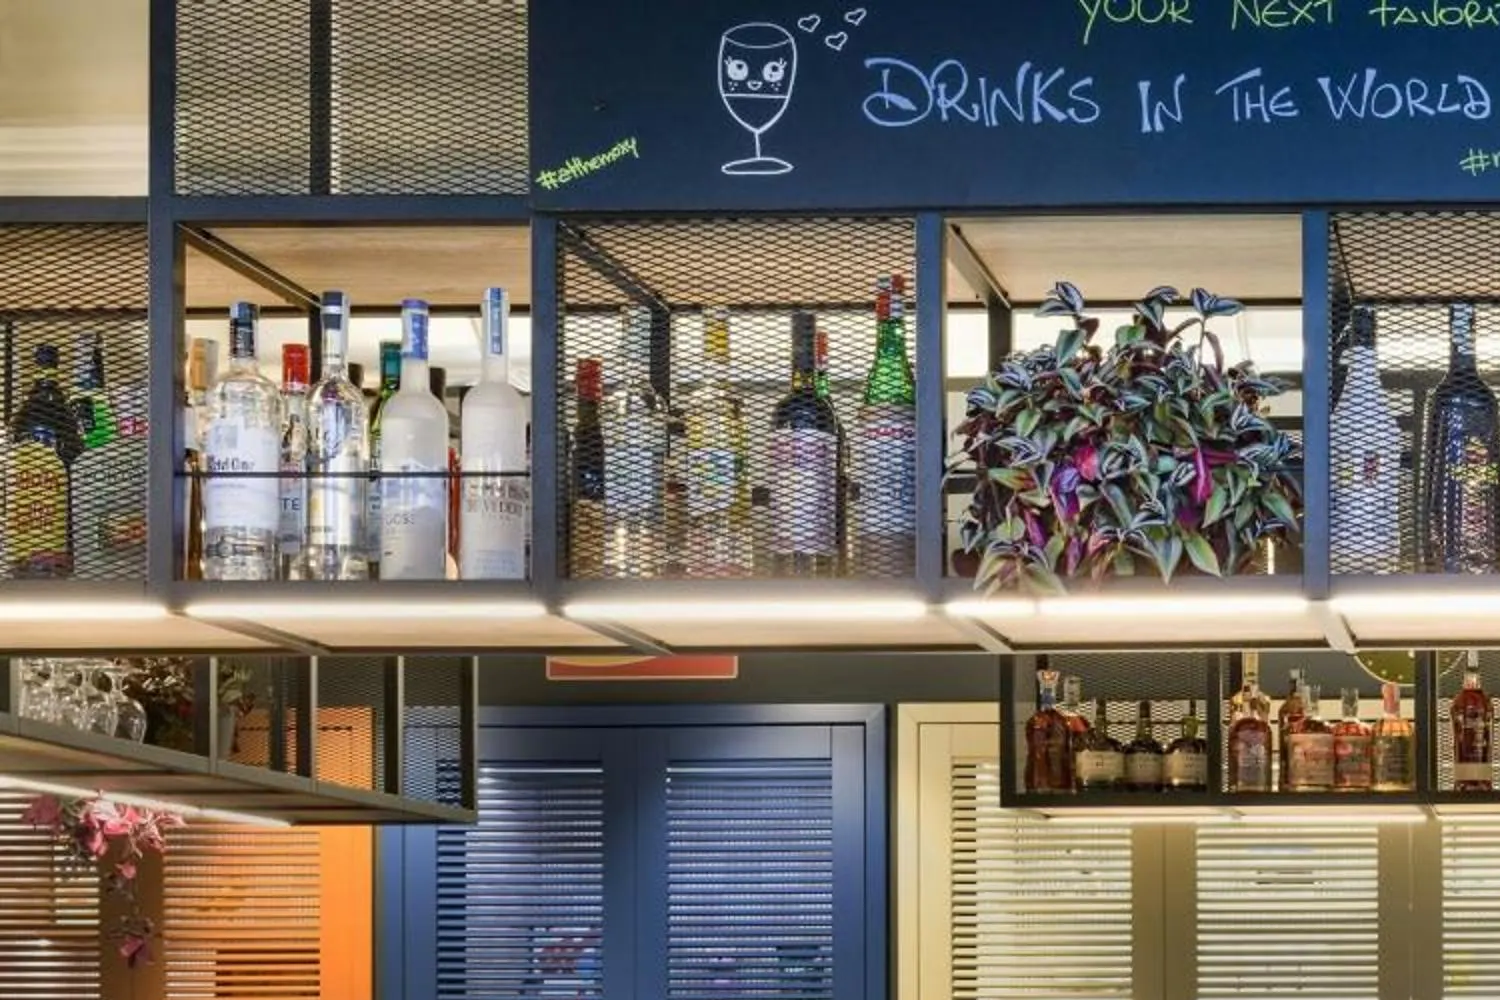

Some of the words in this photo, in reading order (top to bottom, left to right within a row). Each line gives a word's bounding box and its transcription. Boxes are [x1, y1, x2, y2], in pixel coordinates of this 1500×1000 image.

[1232, 0, 1332, 30] NEXT
[862, 57, 1100, 127] DRINKS
[1139, 73, 1185, 133] IN
[1216, 68, 1298, 123] THE
